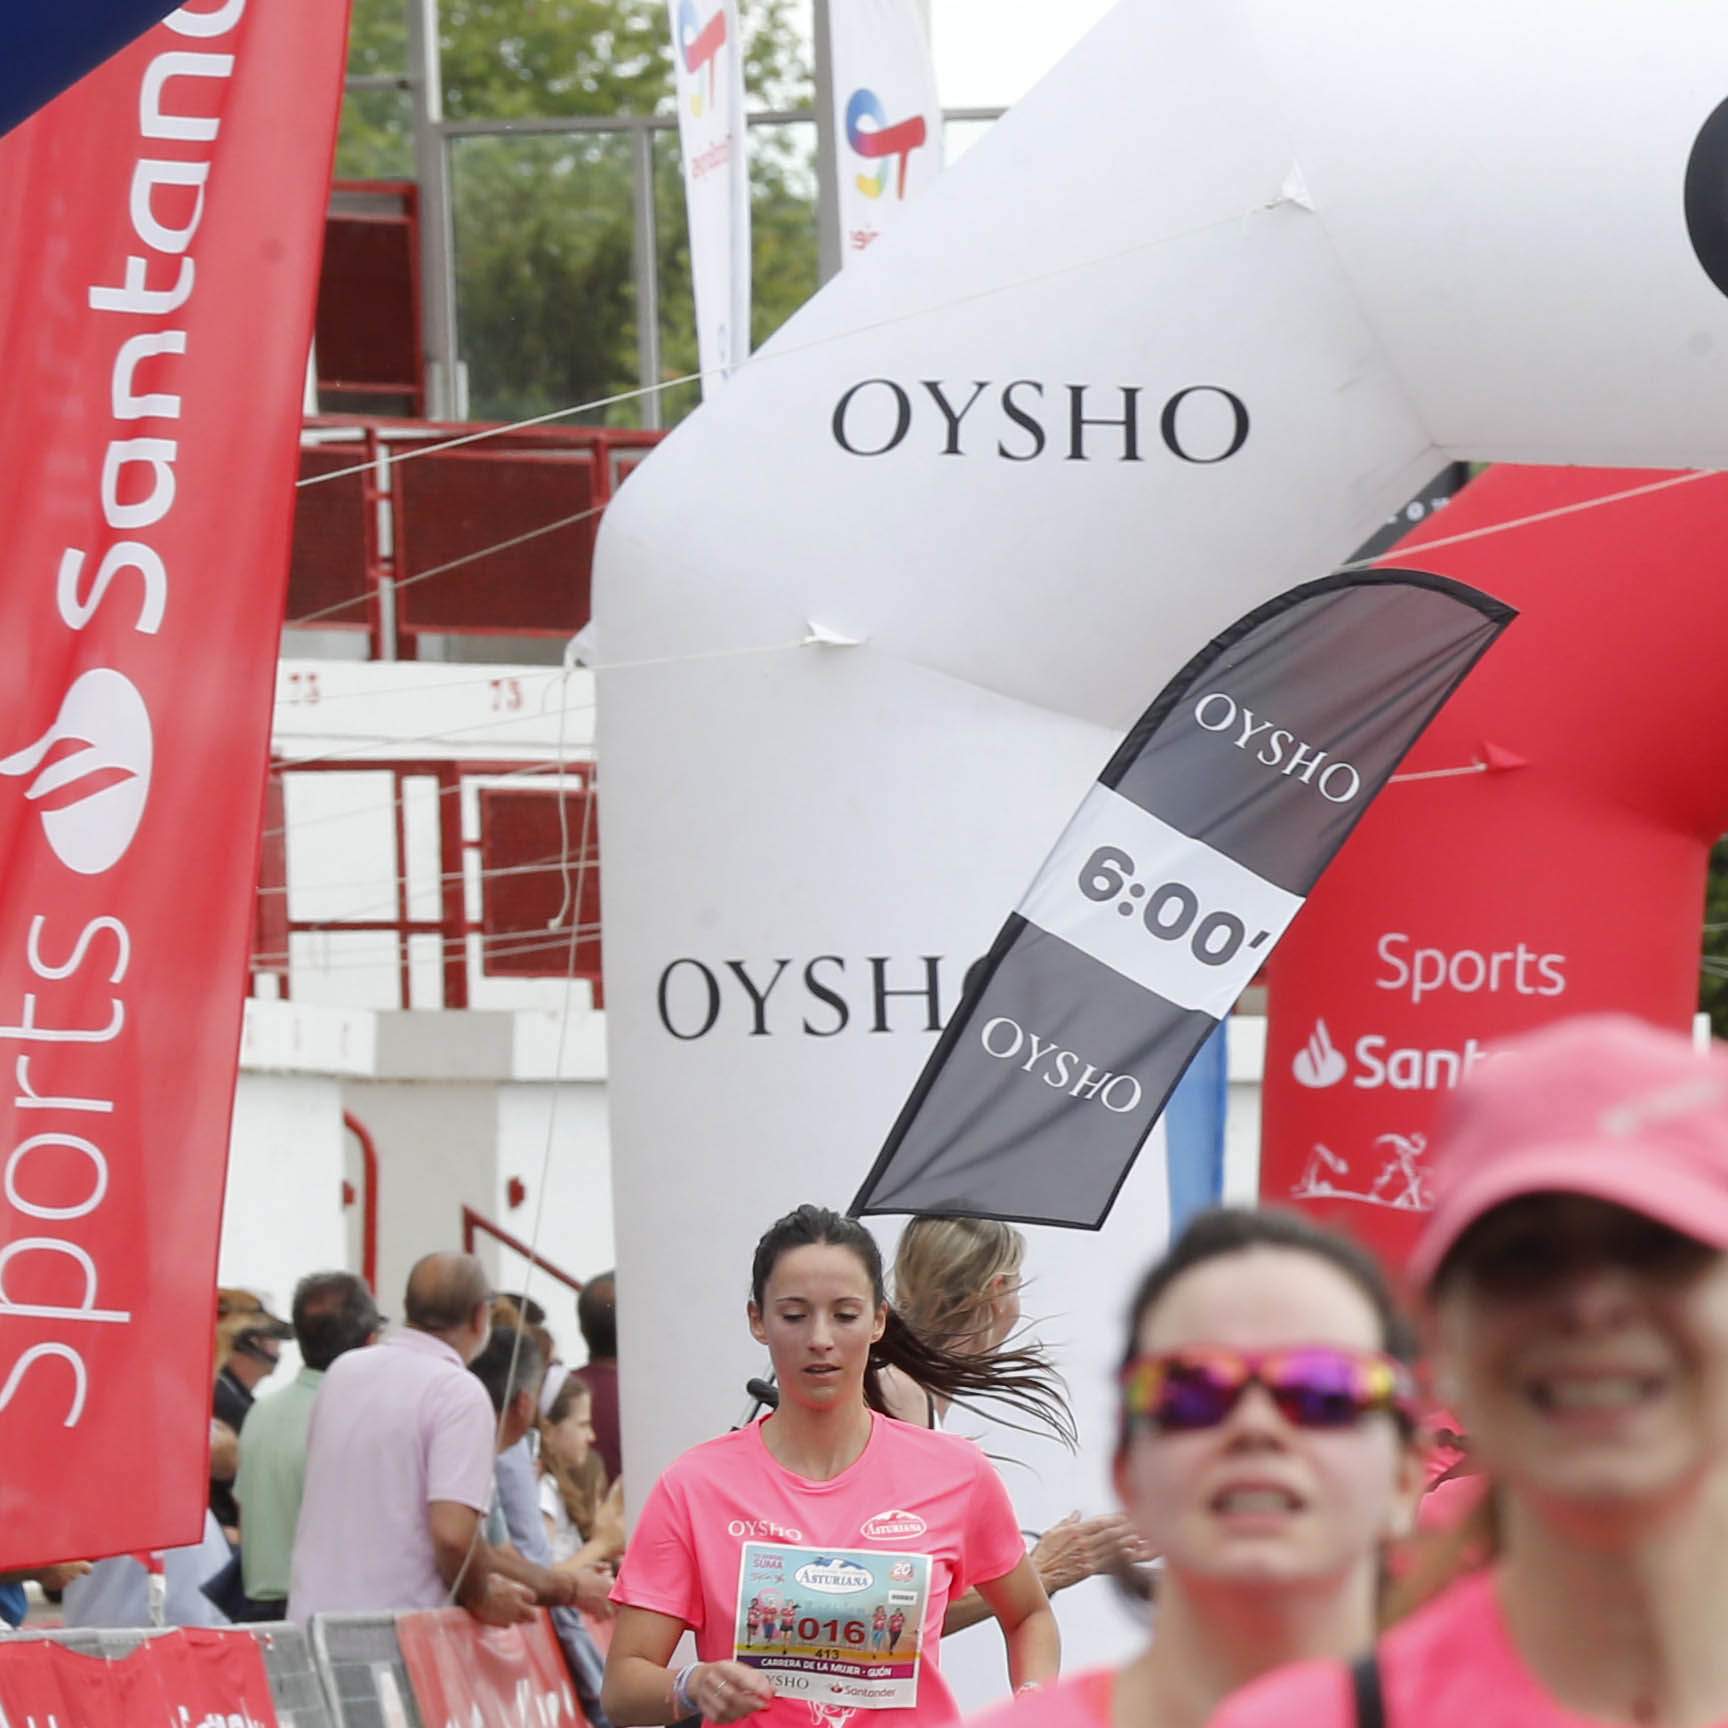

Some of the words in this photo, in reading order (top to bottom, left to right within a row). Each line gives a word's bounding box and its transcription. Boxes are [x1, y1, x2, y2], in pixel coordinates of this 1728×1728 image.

[831, 379, 1251, 464] OYSHO
[1195, 693, 1361, 805] OYSHO
[1376, 933, 1566, 1004] Sports
[657, 954, 988, 1041] OYSH
[982, 1016, 1143, 1114] OYSHO
[0, 913, 131, 1428] Sports
[728, 1519, 803, 1541] OYSHO
[802, 1569, 869, 1588] ASTURIANA
[797, 1616, 866, 1645] 016
[761, 1657, 802, 1670] CARRERA
[803, 1660, 816, 1670] DE
[817, 1661, 829, 1672] LA
[831, 1662, 861, 1675] MUJER
[814, 1648, 840, 1661] 413
[765, 1674, 810, 1690] YSHO
[844, 1685, 897, 1698] Santander
